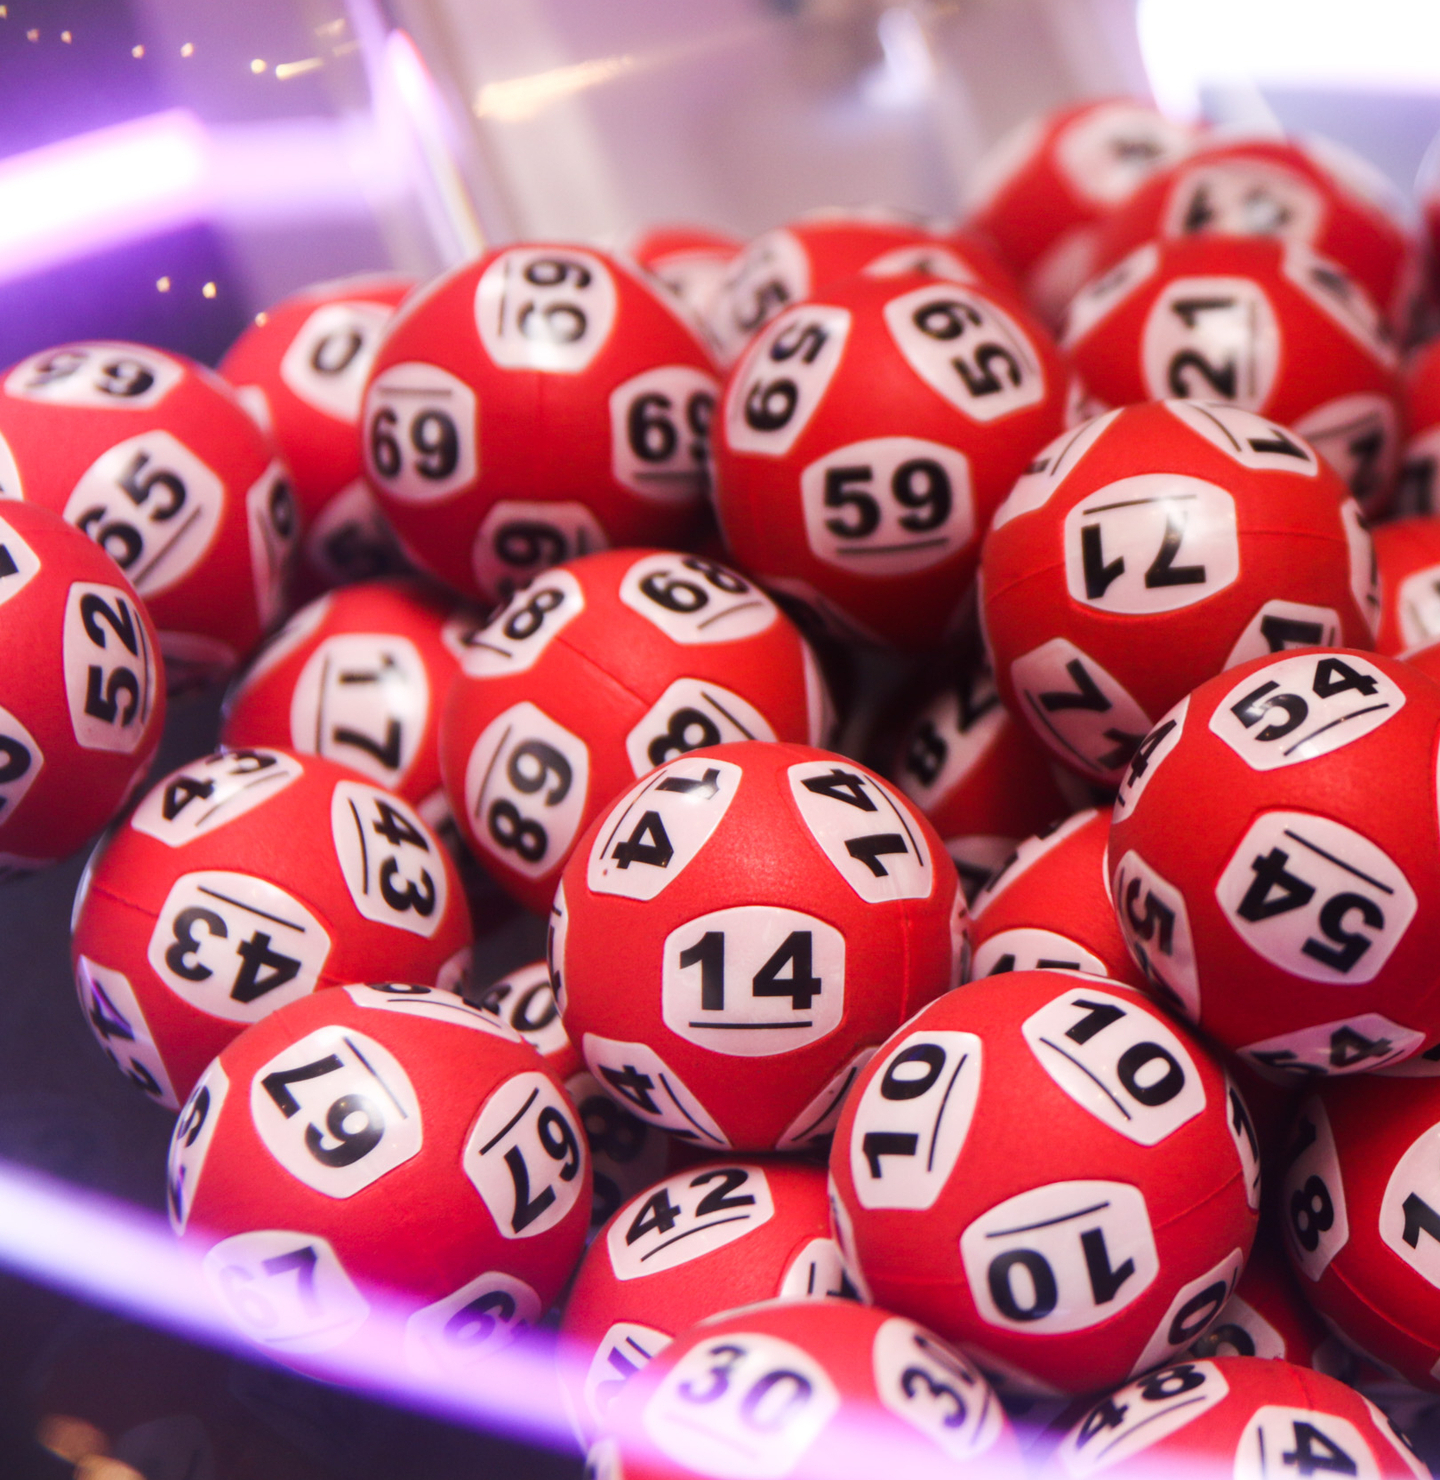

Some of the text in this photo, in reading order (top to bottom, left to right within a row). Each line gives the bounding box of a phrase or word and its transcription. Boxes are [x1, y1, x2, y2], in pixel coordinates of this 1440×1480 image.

[517, 258, 592, 345] 69
[912, 300, 1023, 398] 59
[1167, 296, 1238, 401] 21
[745, 322, 849, 432] 59
[370, 406, 460, 481] 69
[77, 453, 186, 569] 65
[825, 458, 953, 540] 59
[639, 556, 750, 614] 68
[1081, 512, 1207, 600] 71
[81, 593, 139, 728] 52
[333, 650, 404, 770] 17
[1229, 657, 1380, 743] 54
[488, 739, 573, 863] 68
[611, 768, 720, 870] 14
[800, 768, 909, 878] 14
[372, 798, 437, 917] 43
[164, 906, 302, 1004] 43
[1236, 846, 1386, 974] 54
[679, 931, 822, 1011] 14
[1065, 998, 1186, 1107] 10
[261, 1053, 385, 1168] 67
[861, 1043, 947, 1180] 10
[502, 1105, 581, 1234] 67
[625, 1167, 757, 1247] 42
[987, 1227, 1135, 1323] 10
[677, 1344, 813, 1432] 30
[1076, 1363, 1207, 1449] 48
